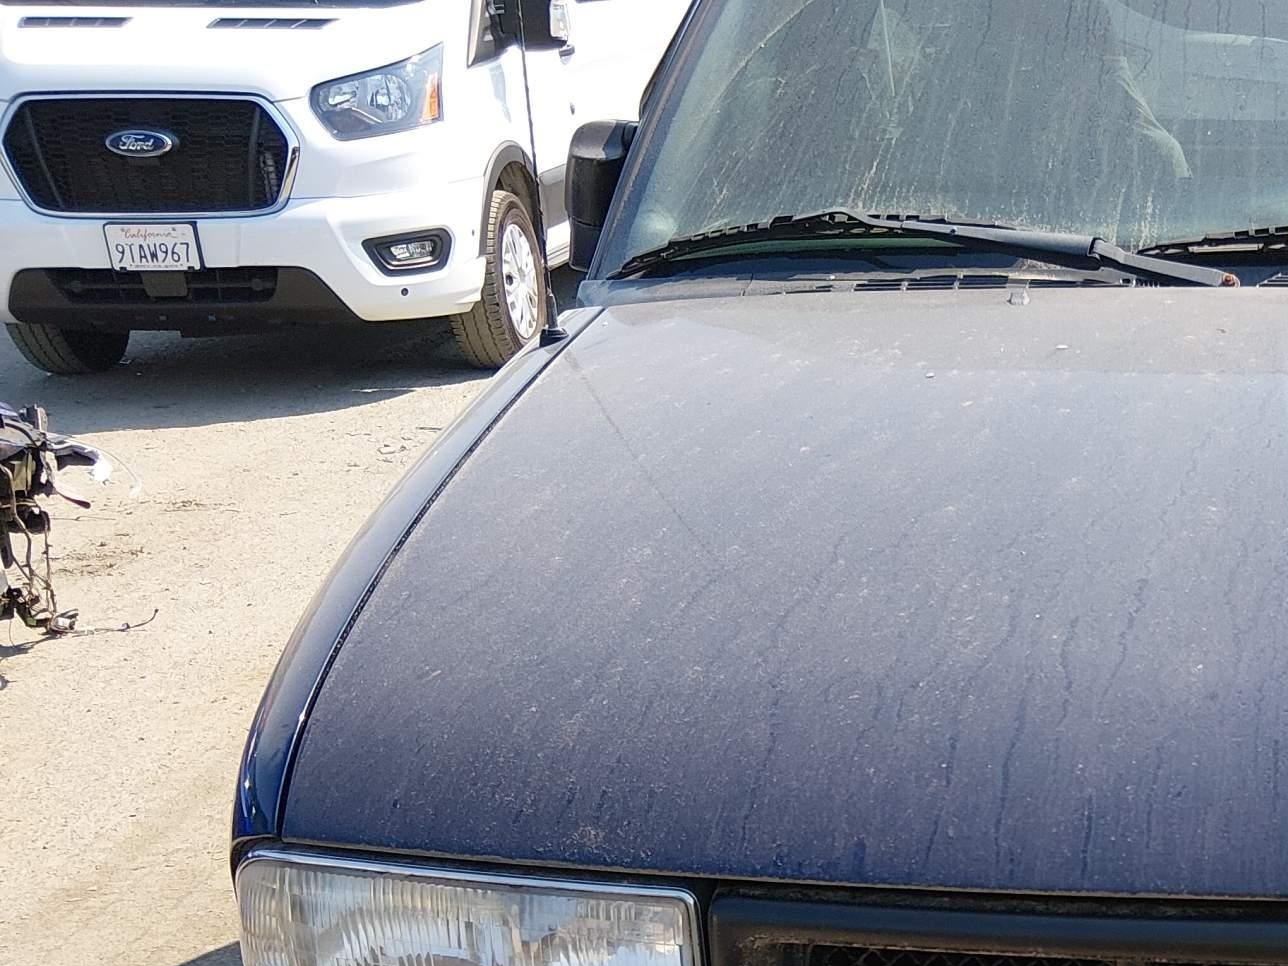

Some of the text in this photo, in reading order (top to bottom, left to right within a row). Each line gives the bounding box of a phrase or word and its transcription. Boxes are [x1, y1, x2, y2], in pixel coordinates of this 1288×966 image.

[119, 134, 155, 151] Ford
[123, 228, 178, 241] California
[115, 242, 190, 264] 9TAW967
